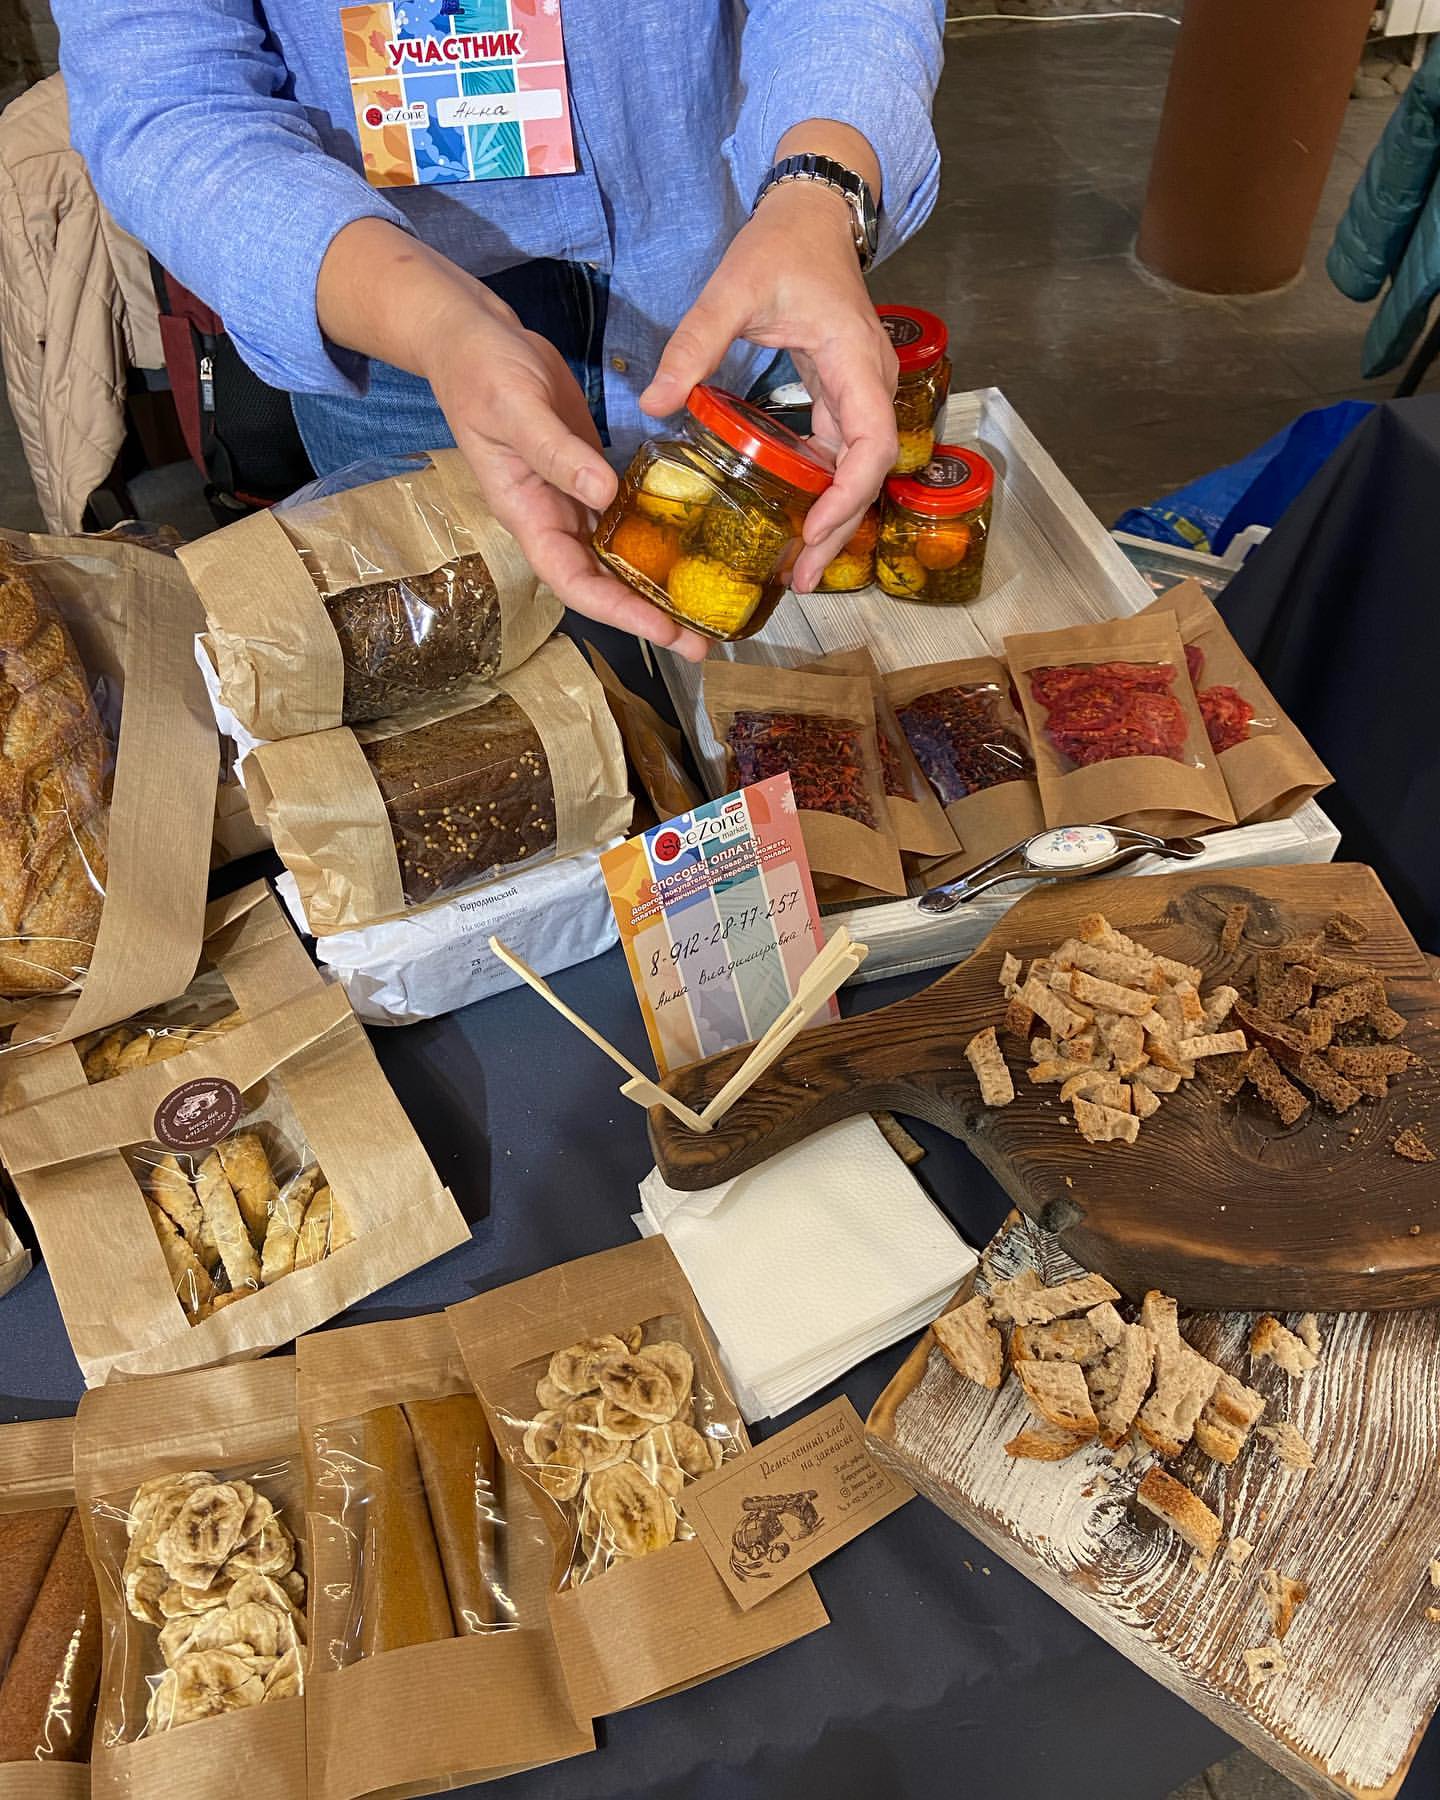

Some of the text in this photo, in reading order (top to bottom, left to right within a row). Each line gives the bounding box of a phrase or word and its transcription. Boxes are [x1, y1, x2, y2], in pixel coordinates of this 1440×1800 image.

[389, 33, 521, 66] УЧАСТНИК
[453, 103, 508, 118] Анна
[661, 808, 746, 856] SeeZone
[722, 822, 749, 841] market
[630, 904, 665, 925] оплатить
[665, 883, 708, 907] наличными
[723, 860, 762, 883] перевести
[763, 846, 791, 862] онлайн
[631, 892, 663, 916] Дорогой
[720, 858, 742, 874] товар
[756, 838, 786, 855] можете
[650, 837, 763, 894] СПОСОБЫ ОПЛАТЫ
[458, 886, 519, 913] Бородинский
[650, 889, 799, 977] 8-912-28-77-257
[655, 984, 689, 1010] Анна
[698, 930, 800, 985] Владимировна
[826, 1417, 847, 1440] хлеб
[800, 1460, 815, 1473] на
